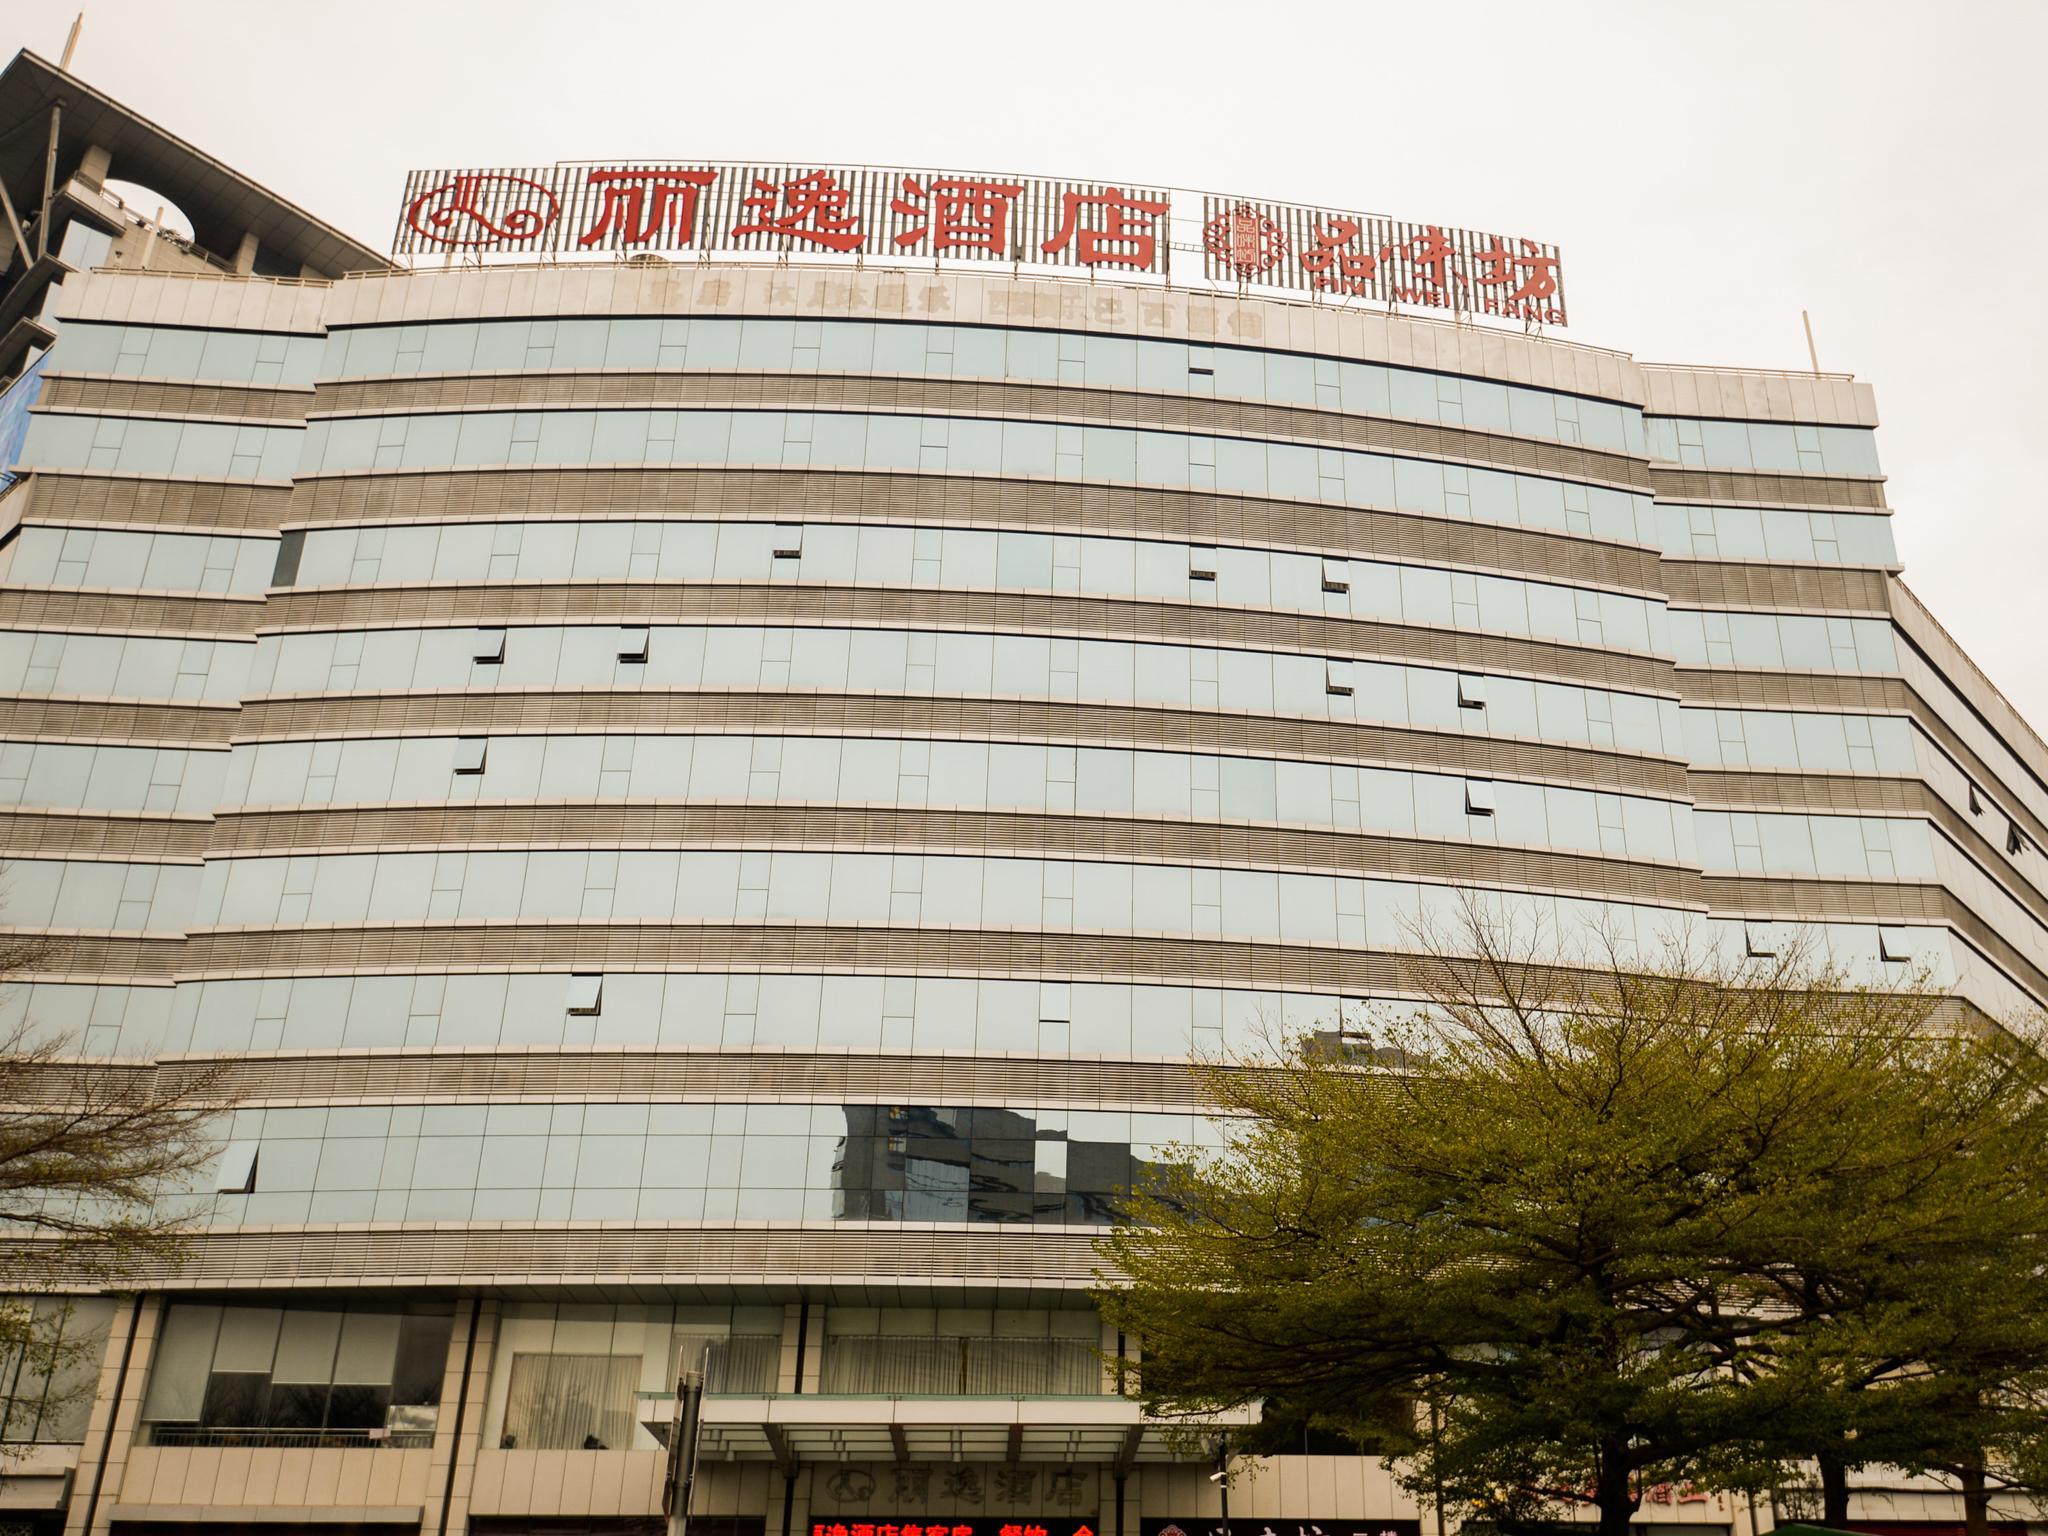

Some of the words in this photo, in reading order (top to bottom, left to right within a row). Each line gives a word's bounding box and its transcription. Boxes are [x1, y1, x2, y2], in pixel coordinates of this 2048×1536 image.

[578, 169, 1172, 271] 丽逸酒店
[1299, 219, 1560, 301] 品味坊
[1314, 276, 1365, 296] PIN
[1393, 288, 1451, 308] WEI
[1484, 299, 1566, 325] FANG
